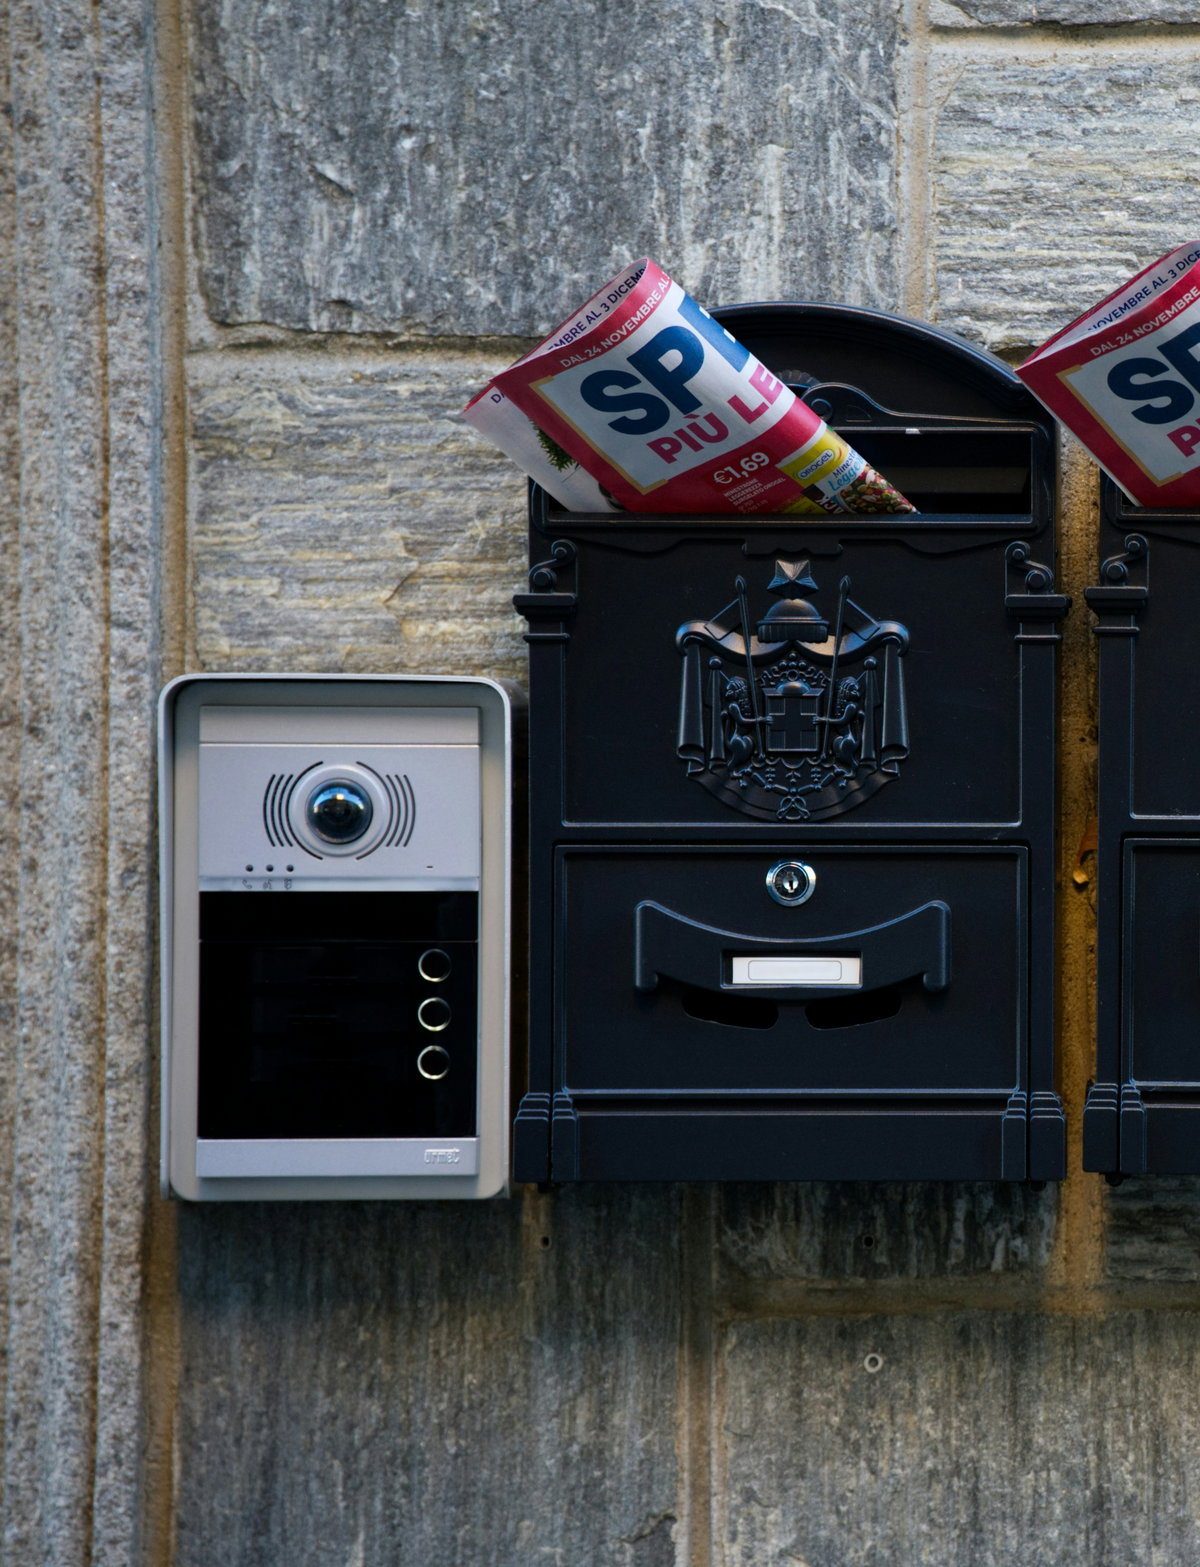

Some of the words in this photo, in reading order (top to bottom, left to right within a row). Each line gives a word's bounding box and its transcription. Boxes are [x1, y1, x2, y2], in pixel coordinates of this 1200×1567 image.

[548, 321, 587, 350] MBRE
[585, 310, 602, 324] AL
[600, 302, 610, 312] 3
[560, 352, 586, 368] DAL
[584, 345, 602, 356] 24
[600, 290, 662, 349] NOVEMBRE
[657, 278, 670, 295] AL
[1088, 286, 1152, 331] OVEMBRE
[1151, 276, 1168, 290] AL
[1167, 269, 1177, 279] 3
[1090, 342, 1118, 356] DAL
[1115, 333, 1134, 345] 24
[1132, 286, 1200, 337] NOVEMBRE
[646, 411, 729, 464] PIÙ
[727, 363, 784, 425] LE
[713, 451, 770, 485] €1,69
